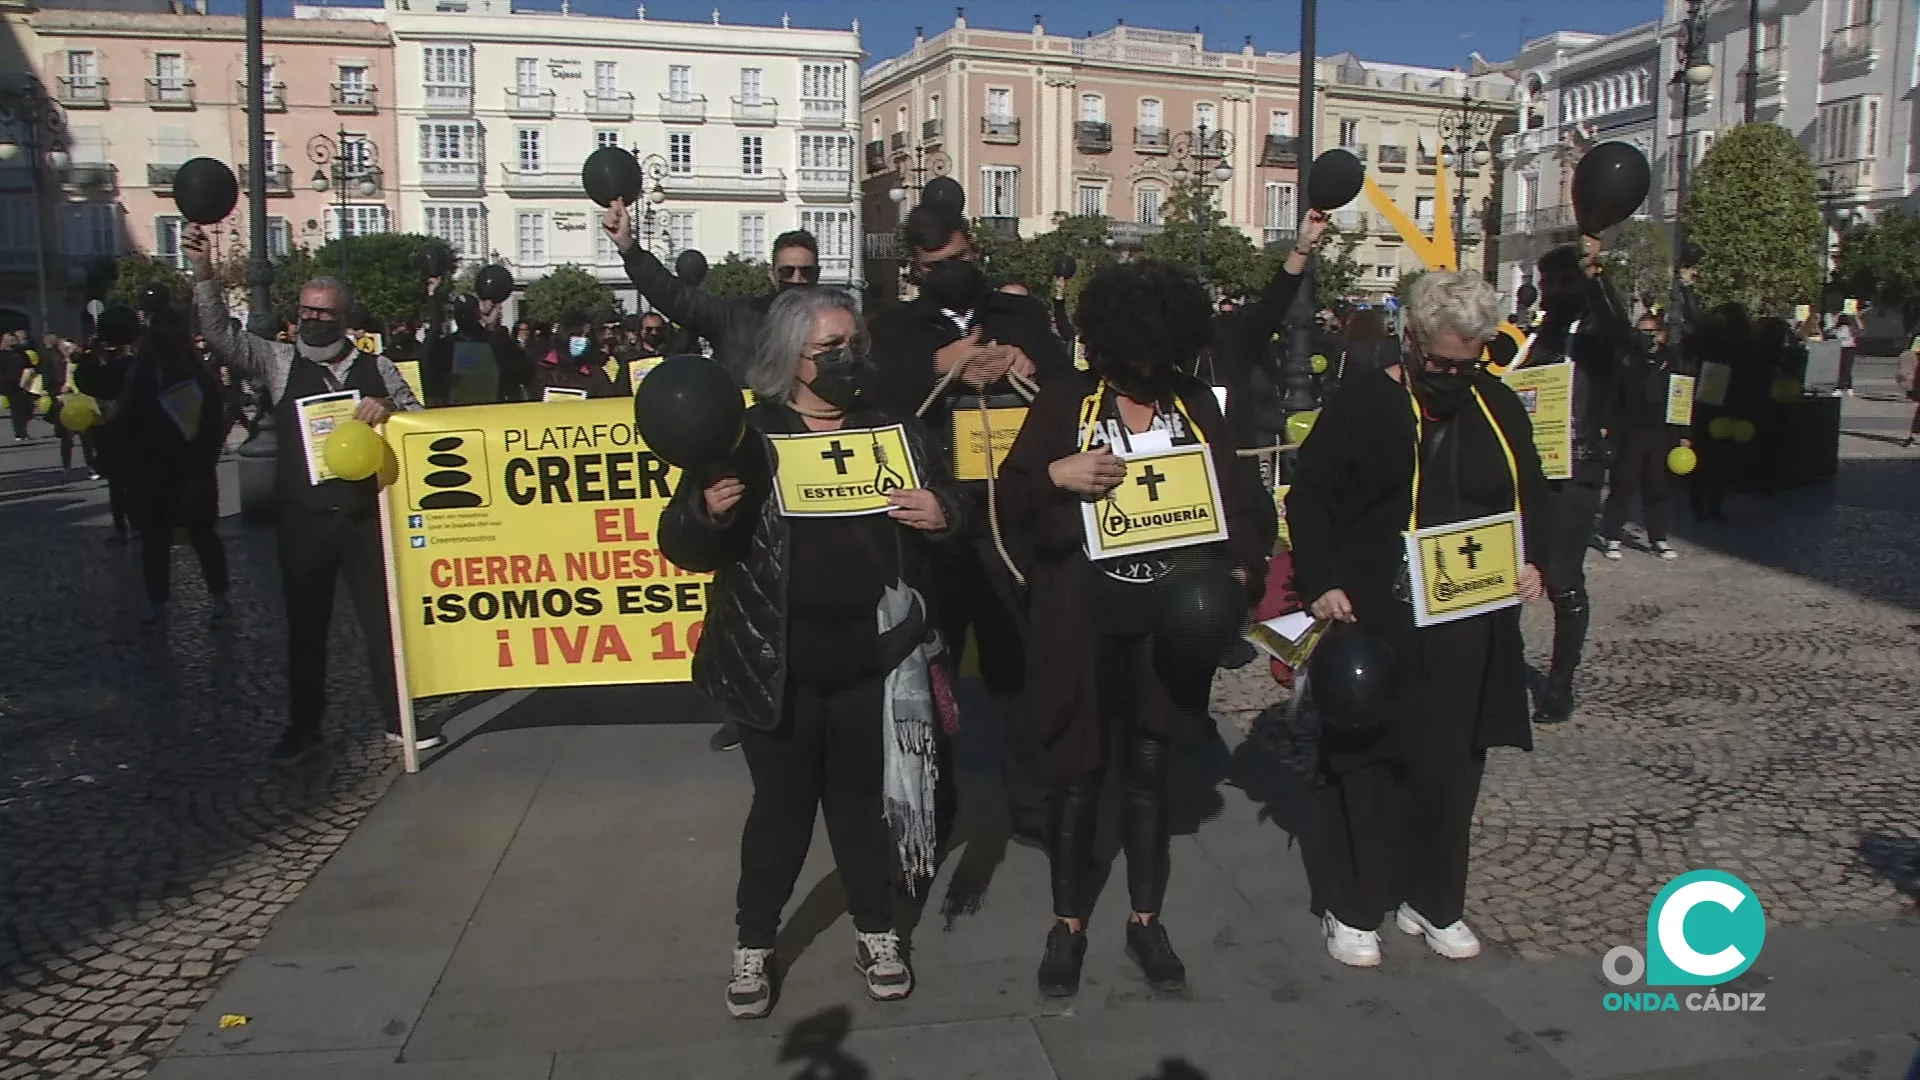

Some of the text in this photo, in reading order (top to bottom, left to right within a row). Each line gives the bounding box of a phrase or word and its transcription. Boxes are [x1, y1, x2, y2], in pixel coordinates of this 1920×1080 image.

[505, 450, 673, 506] CREER
[595, 507, 649, 543] EL
[1110, 506, 1209, 532] PELUQUERÍA
[430, 553, 556, 588] CIERRA
[422, 587, 604, 626] ¡SOMOS
[532, 624, 632, 666] IVA
